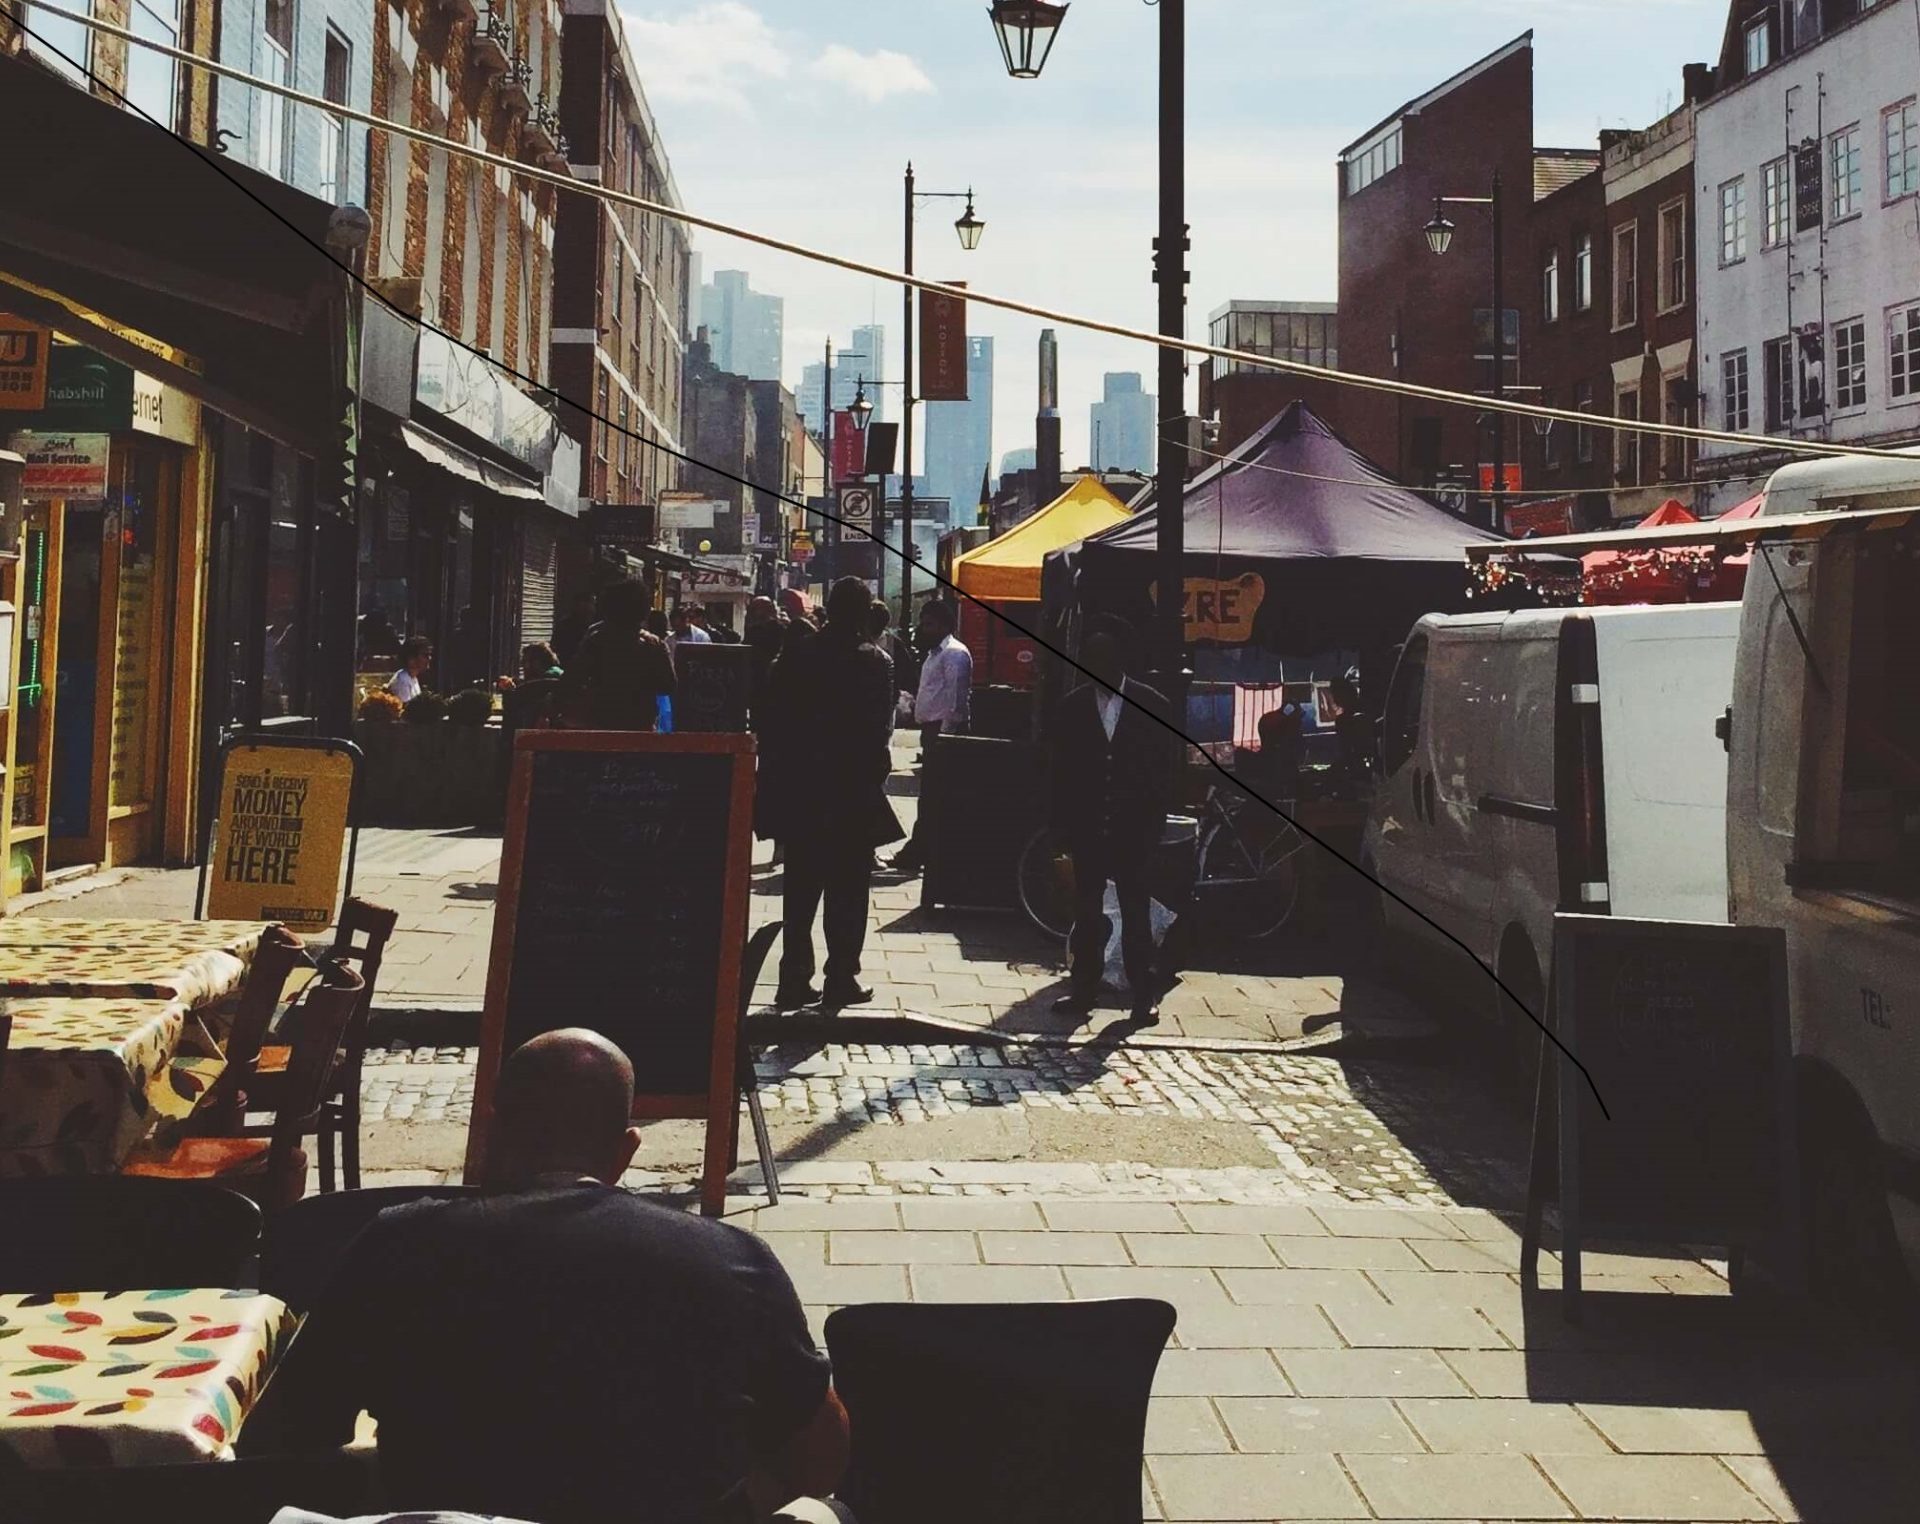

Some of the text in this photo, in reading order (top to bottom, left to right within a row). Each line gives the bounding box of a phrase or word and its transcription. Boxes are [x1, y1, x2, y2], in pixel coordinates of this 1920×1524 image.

[272, 775, 309, 790] RECEIVE
[232, 788, 308, 816] MONEY
[230, 815, 279, 831] AROUND
[230, 829, 301, 848] THE WORLD
[224, 846, 300, 884] HERE
